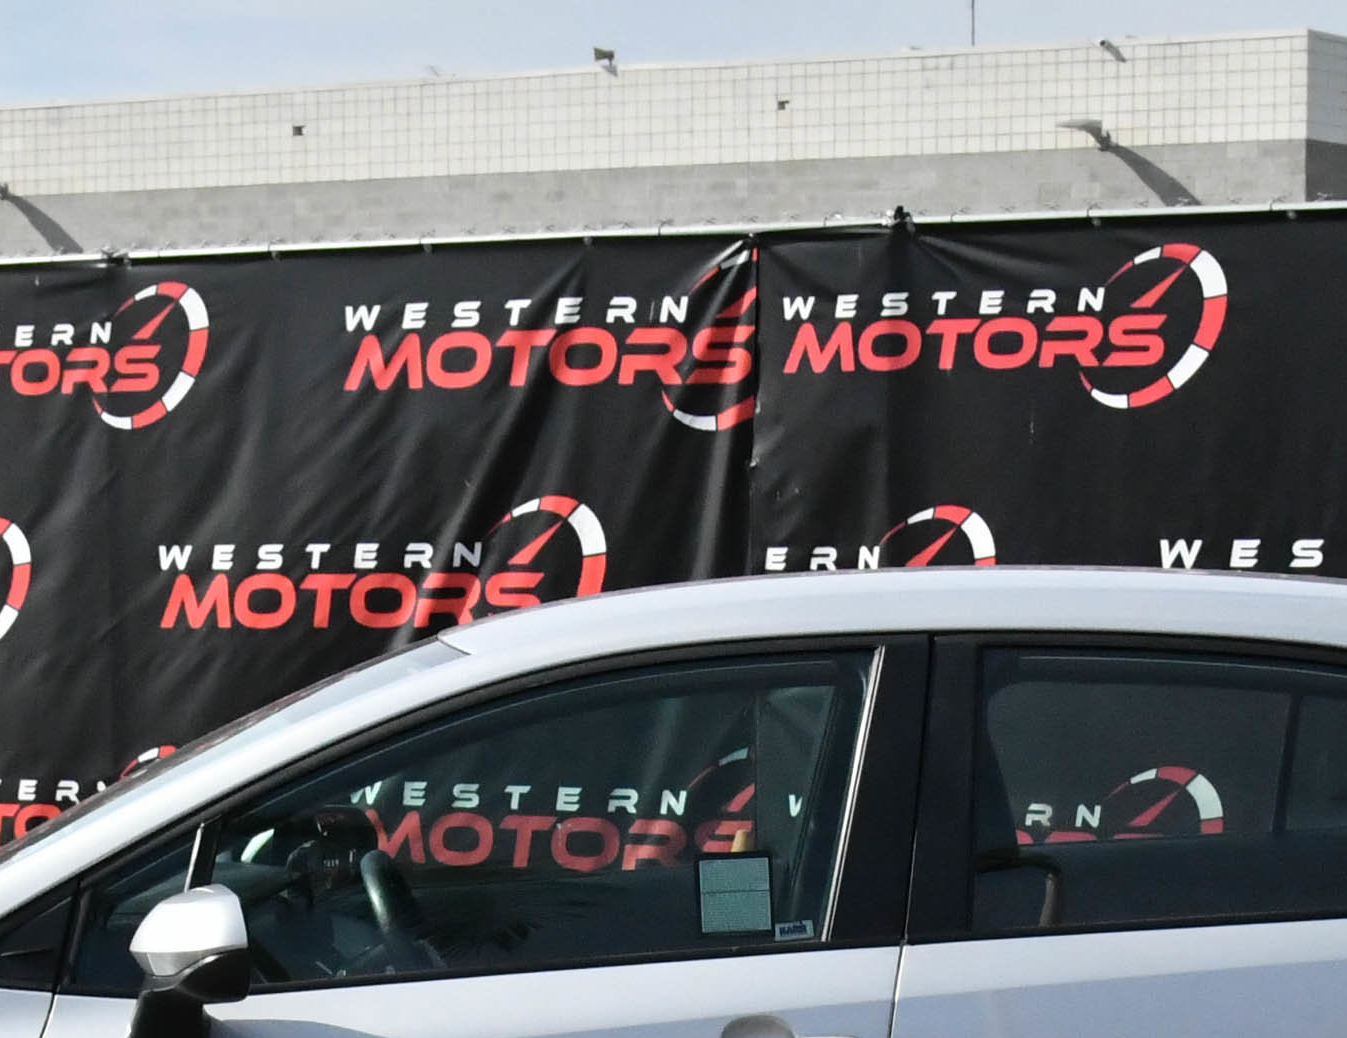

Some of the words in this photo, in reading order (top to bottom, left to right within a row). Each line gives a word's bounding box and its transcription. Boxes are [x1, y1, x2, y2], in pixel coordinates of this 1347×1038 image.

[344, 295, 689, 333] WESTERN
[782, 286, 1106, 321] WESTERN
[343, 323, 754, 392] MOTORS
[783, 313, 1168, 375] MOTORS
[158, 542, 482, 572] WESTERN
[159, 571, 545, 630] MOTORS
[351, 780, 687, 816] WESTERN
